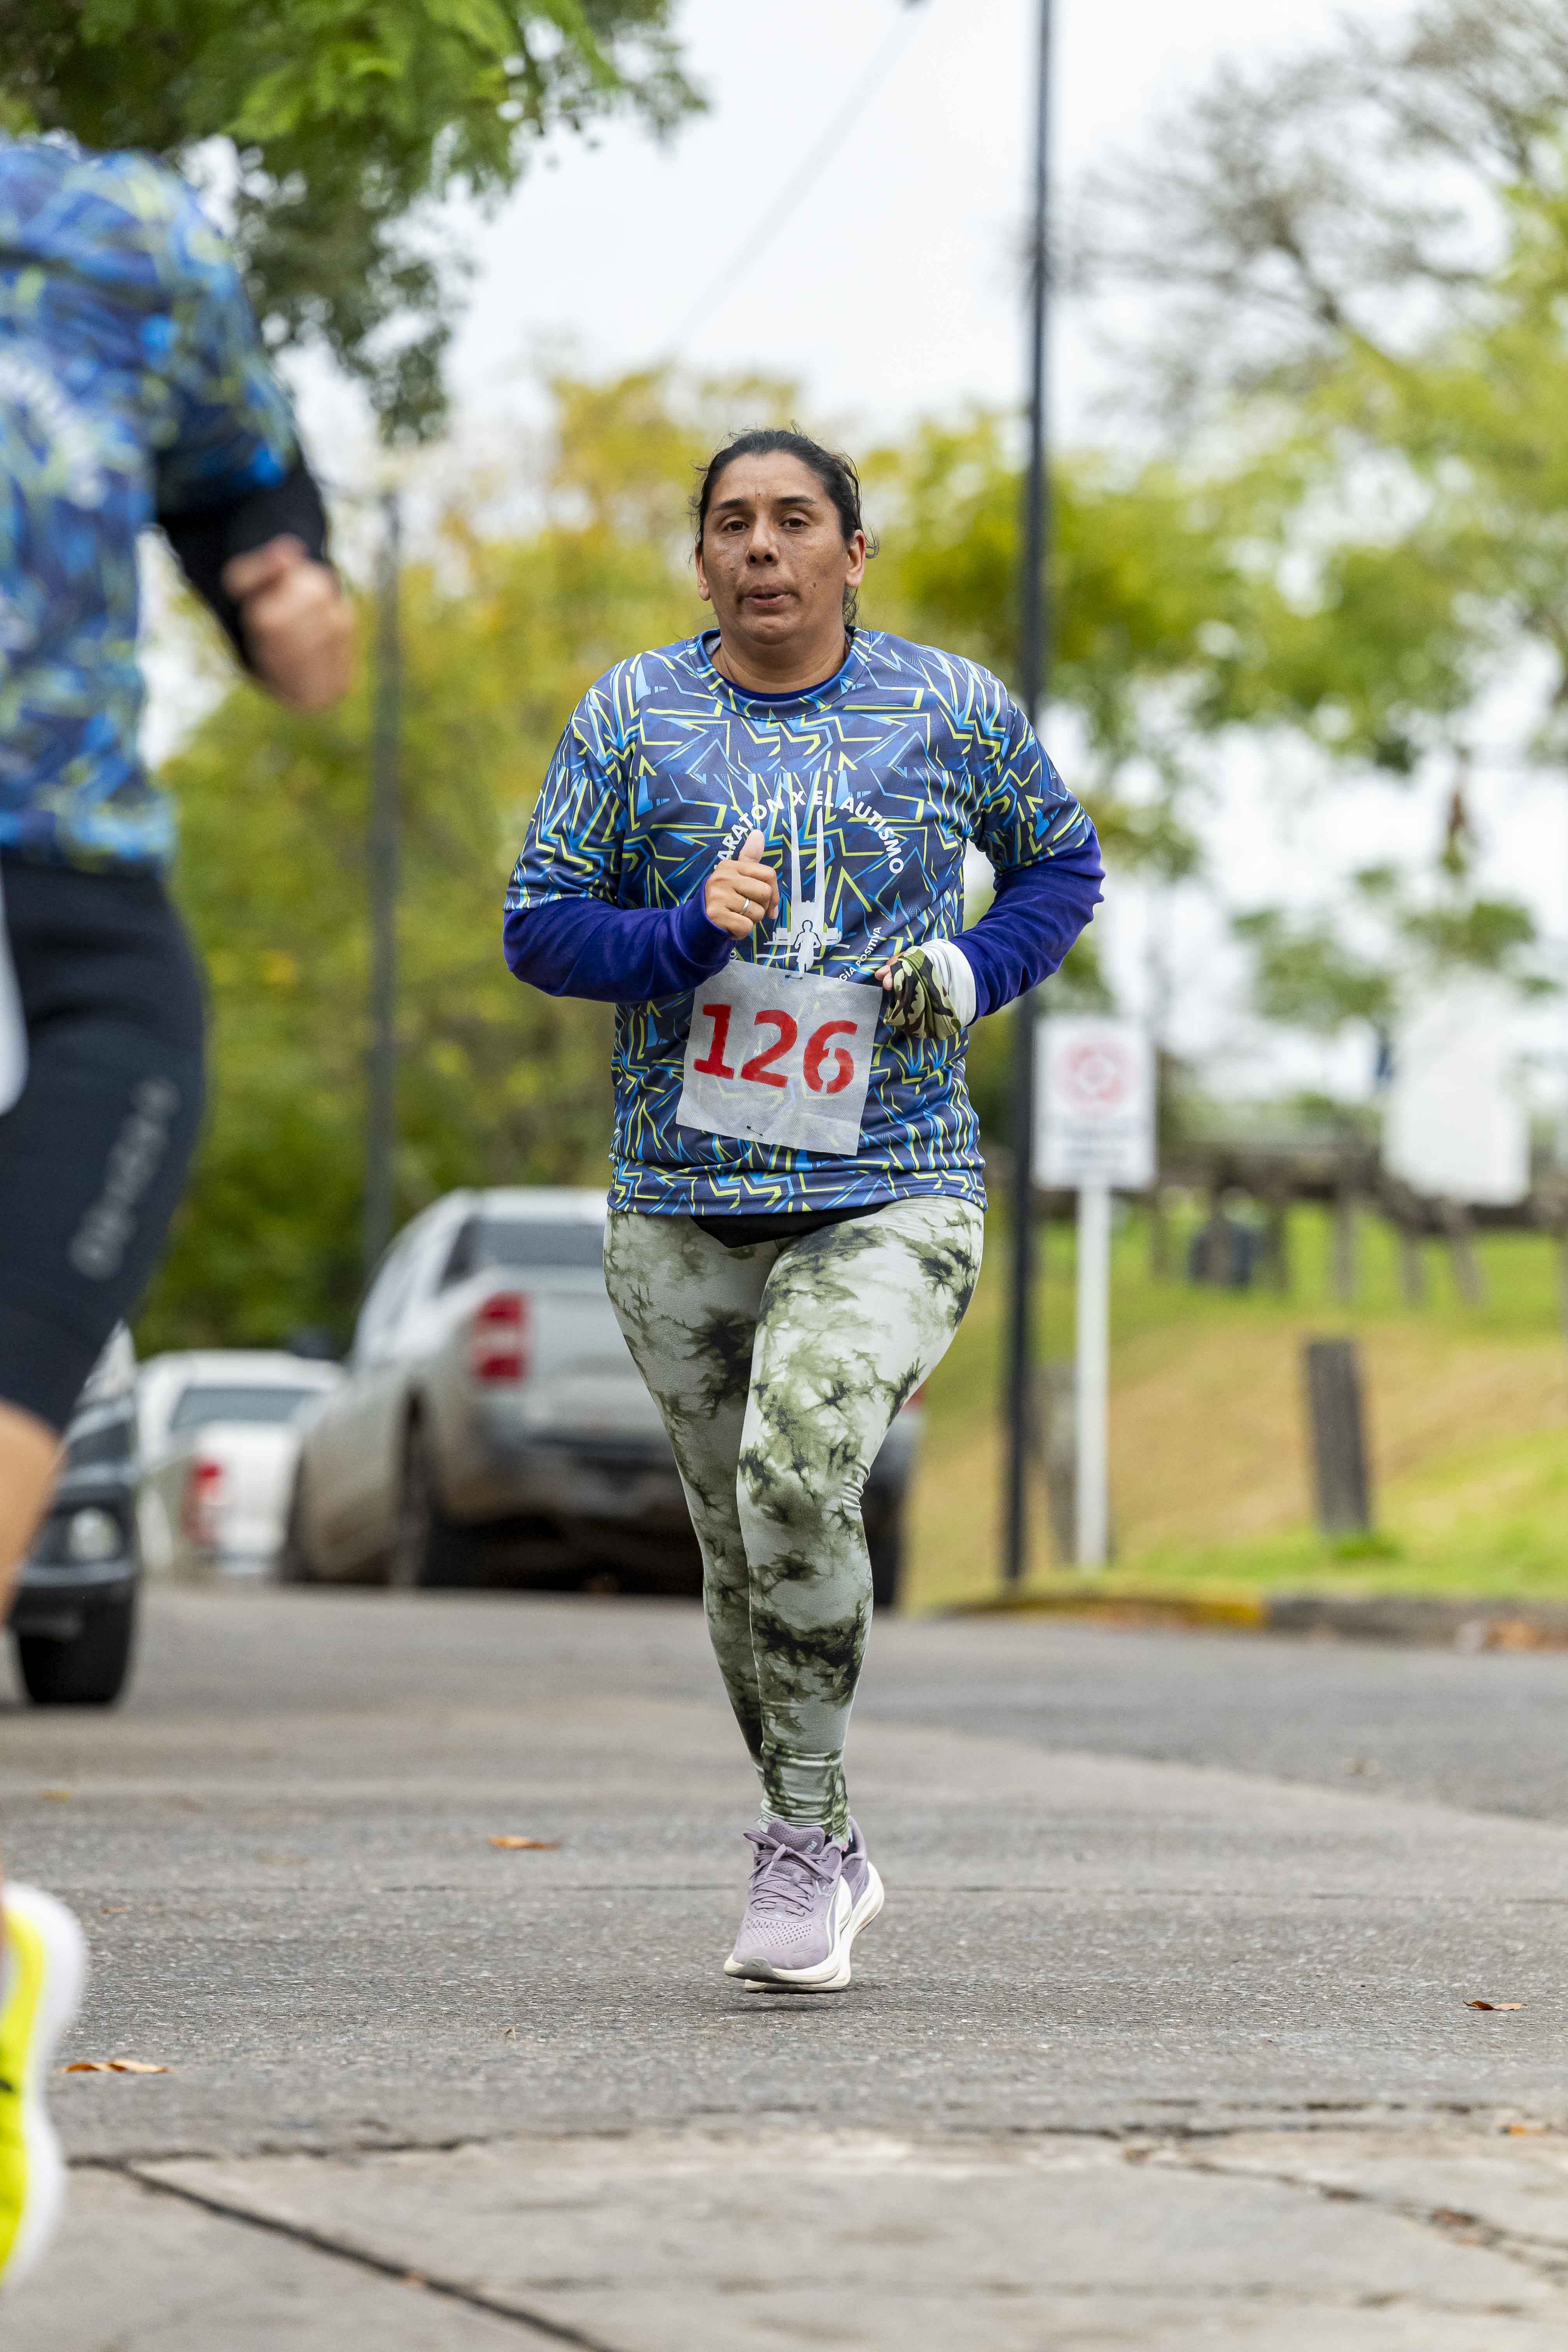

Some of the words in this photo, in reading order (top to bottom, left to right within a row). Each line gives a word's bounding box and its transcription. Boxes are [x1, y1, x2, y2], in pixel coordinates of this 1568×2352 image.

[714, 796, 784, 869] ARATÓN
[792, 791, 806, 806] X
[813, 790, 834, 807] EL
[839, 796, 904, 874] AUTISMO
[837, 967, 857, 981] GÍA
[855, 927, 881, 967] POSITIVA
[694, 1004, 858, 1094] 126
